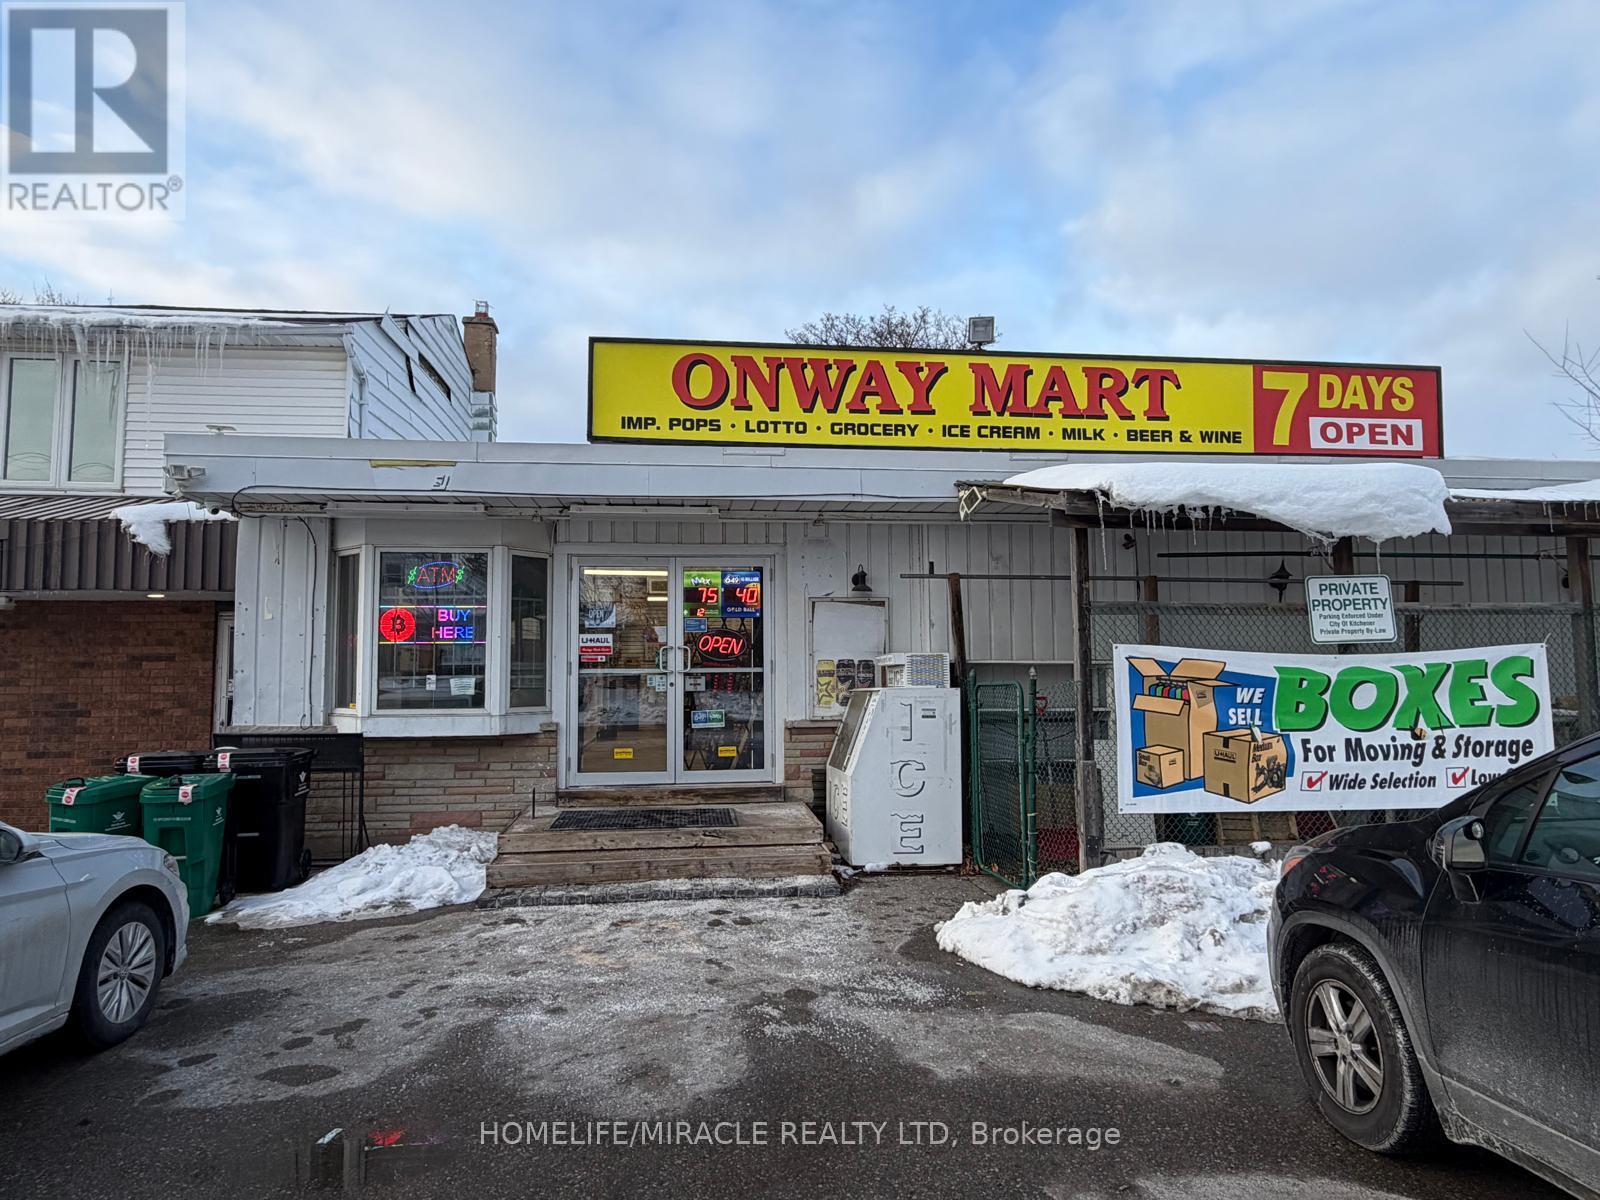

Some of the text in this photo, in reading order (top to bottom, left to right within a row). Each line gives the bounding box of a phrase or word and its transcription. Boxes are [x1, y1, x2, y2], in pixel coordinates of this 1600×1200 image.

[671, 352, 1182, 421] ONWAY MART
[1318, 374, 1415, 412] DAYS
[1262, 370, 1309, 446] 7
[621, 416, 1242, 444] IMP. POPS LOTTO GROCERY ICE CREAM MILK BEER & WINE
[1319, 421, 1414, 446] OPEN
[736, 588, 758, 603] 40
[1319, 582, 1379, 596] PRIVATE
[1312, 598, 1388, 612] PROPERTY
[437, 609, 472, 622] BUY
[431, 626, 475, 639] HERE
[698, 635, 743, 655] OPEN
[1236, 687, 1265, 704] WE
[1273, 656, 1541, 733] BOXES
[1228, 708, 1262, 726] SELL
[1301, 734, 1534, 767] For Moving & Storage
[1328, 770, 1437, 790] Wide Selection
